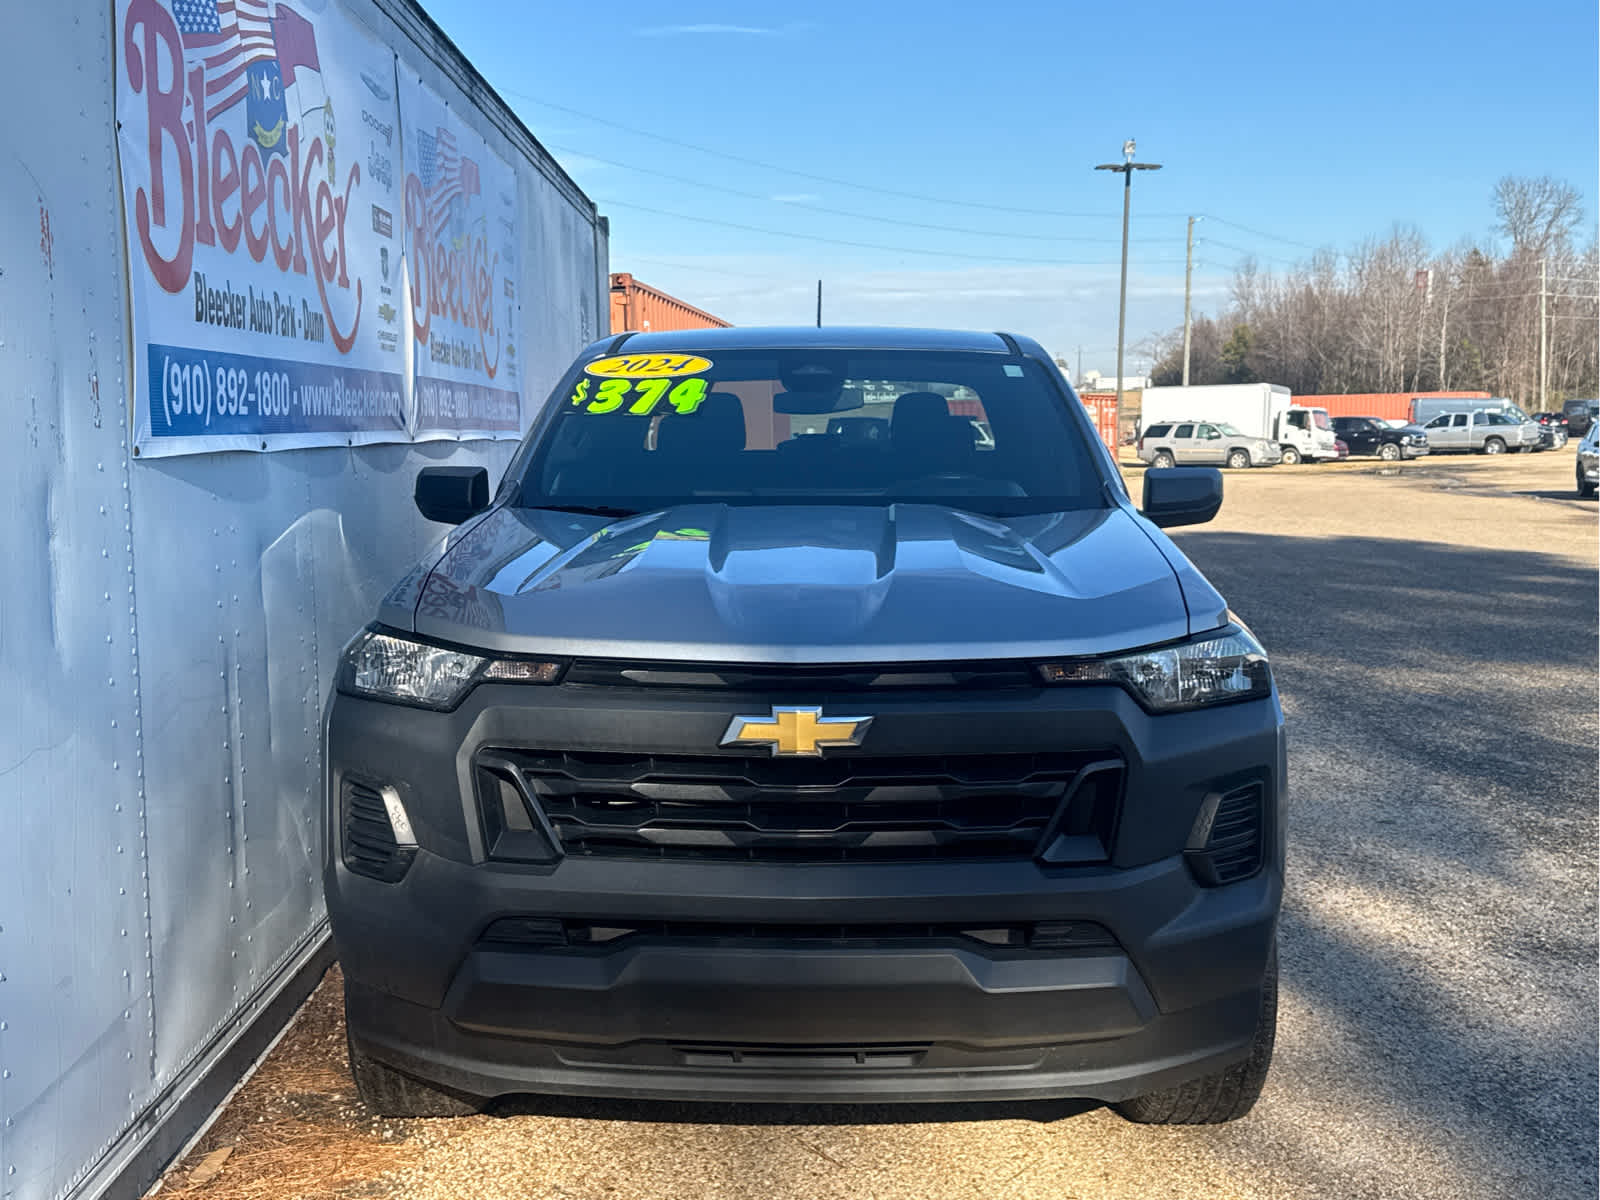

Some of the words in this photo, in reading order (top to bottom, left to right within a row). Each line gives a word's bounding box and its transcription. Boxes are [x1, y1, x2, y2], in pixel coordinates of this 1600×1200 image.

[124, 0, 362, 354] Bleecker
[194, 271, 246, 331] Bleecker
[249, 285, 273, 334] Auto
[273, 291, 297, 338] Park
[303, 299, 325, 344] Dunn
[404, 172, 499, 379] Bleecker
[162, 355, 212, 427] (910)
[215, 366, 290, 417] 892-1800
[300, 377, 401, 418] www.Bleecker.com
[571, 377, 709, 416] $374
[602, 357, 696, 373] 2024
